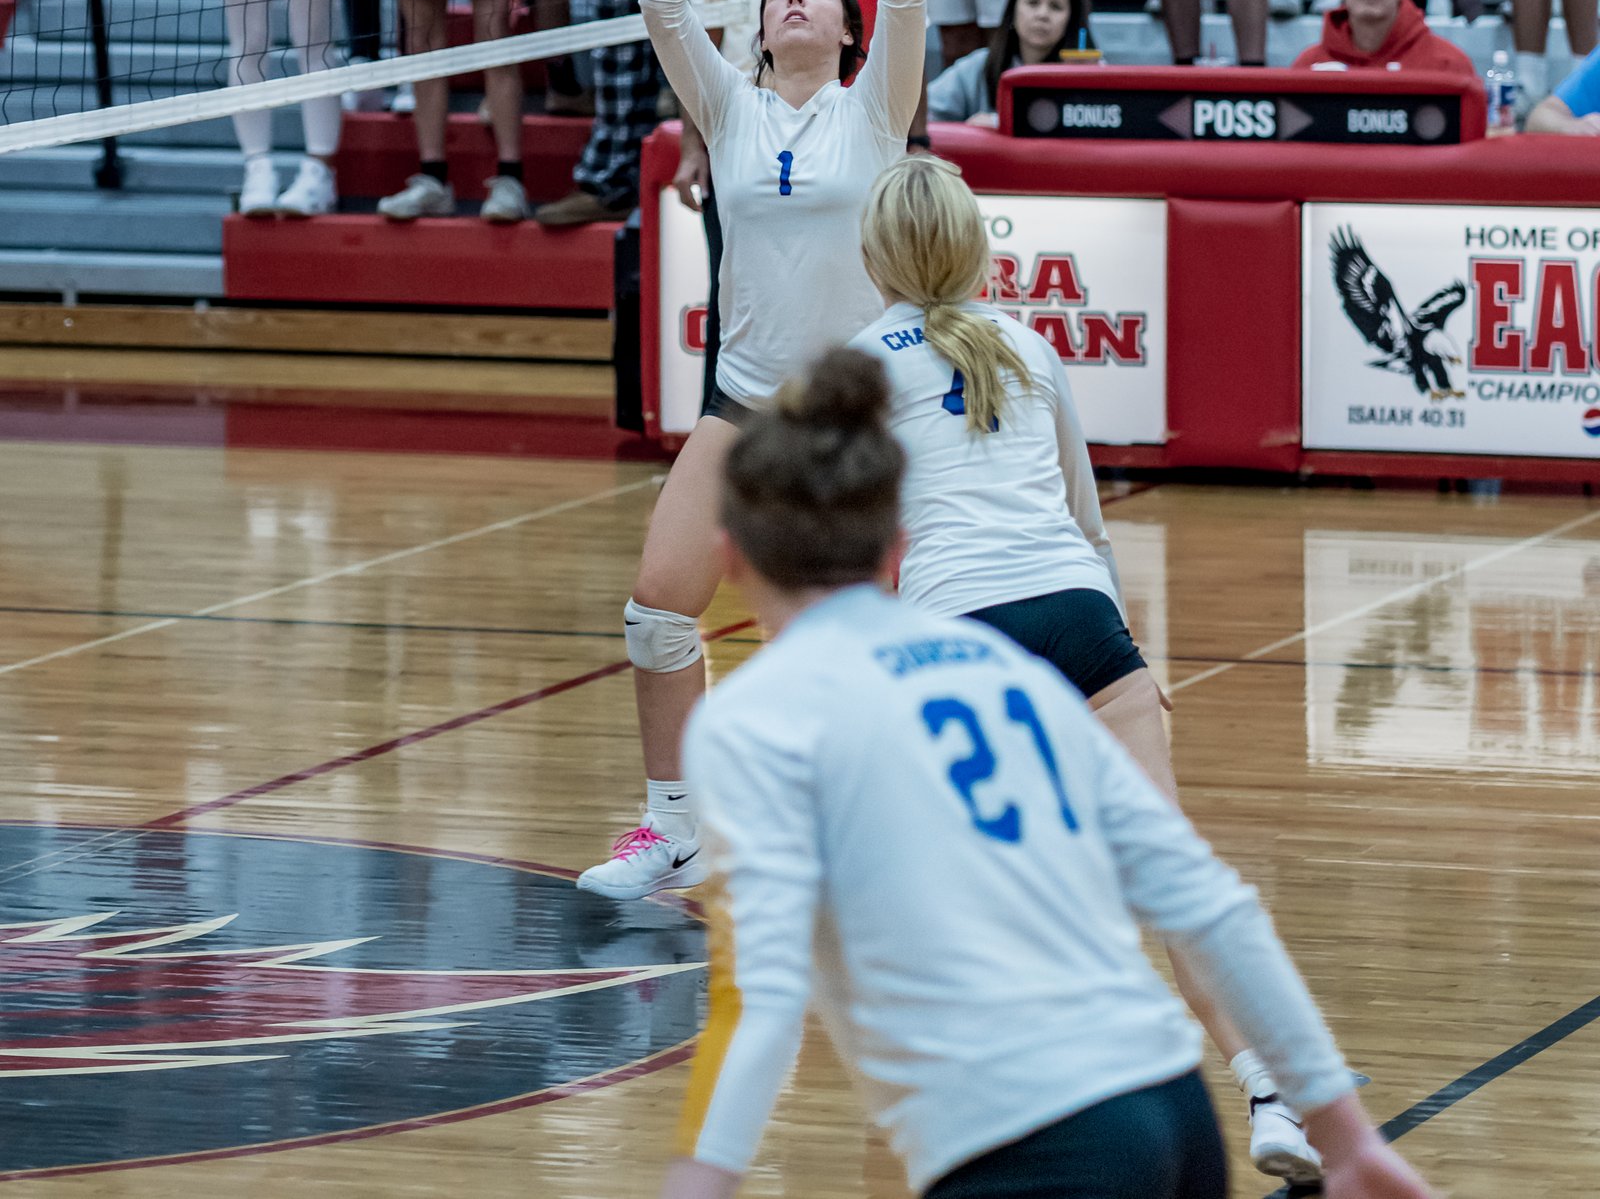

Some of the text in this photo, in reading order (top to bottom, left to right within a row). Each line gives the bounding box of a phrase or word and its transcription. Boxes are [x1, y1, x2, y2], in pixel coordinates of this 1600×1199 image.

[1063, 100, 1409, 138] BONUS POSS BONUS
[776, 150, 794, 196] 1
[1465, 226, 1557, 250] HOME
[1469, 256, 1600, 377] EA
[1348, 406, 1413, 425] ISAIAH
[920, 686, 1081, 844] 21
